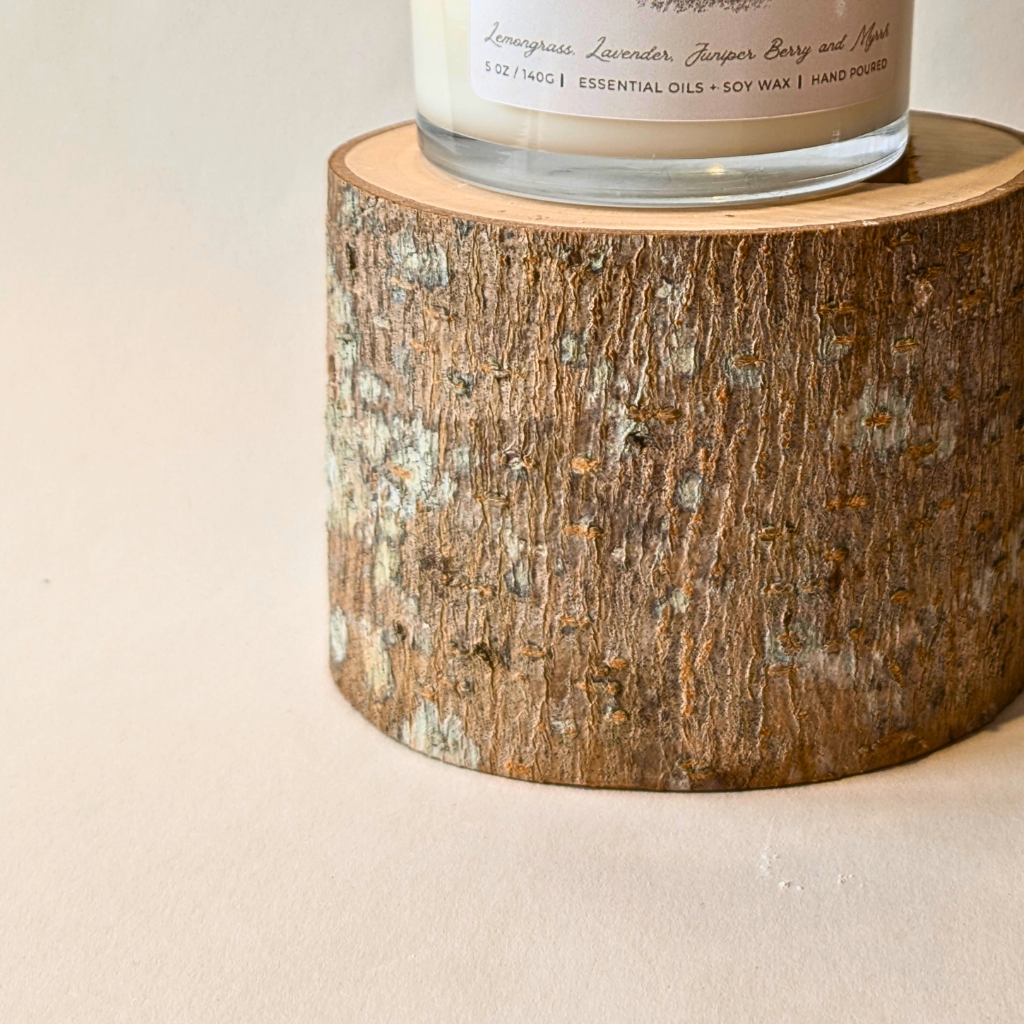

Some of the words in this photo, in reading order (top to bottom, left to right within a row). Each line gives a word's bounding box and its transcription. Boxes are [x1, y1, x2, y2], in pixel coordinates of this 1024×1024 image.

[685, 42, 756, 67] Juniper
[763, 37, 813, 64] Berry
[818, 34, 848, 53] and
[850, 21, 890, 53] Myrrh
[485, 60, 492, 72] 5
[495, 63, 510, 77] OZ
[522, 68, 555, 85] 140G
[579, 76, 663, 94] ESSENTIAL
[668, 81, 704, 94] OILS
[723, 81, 752, 94] SOY
[758, 77, 791, 91] WAX
[811, 69, 846, 86] HAND
[850, 57, 888, 78] POURED
